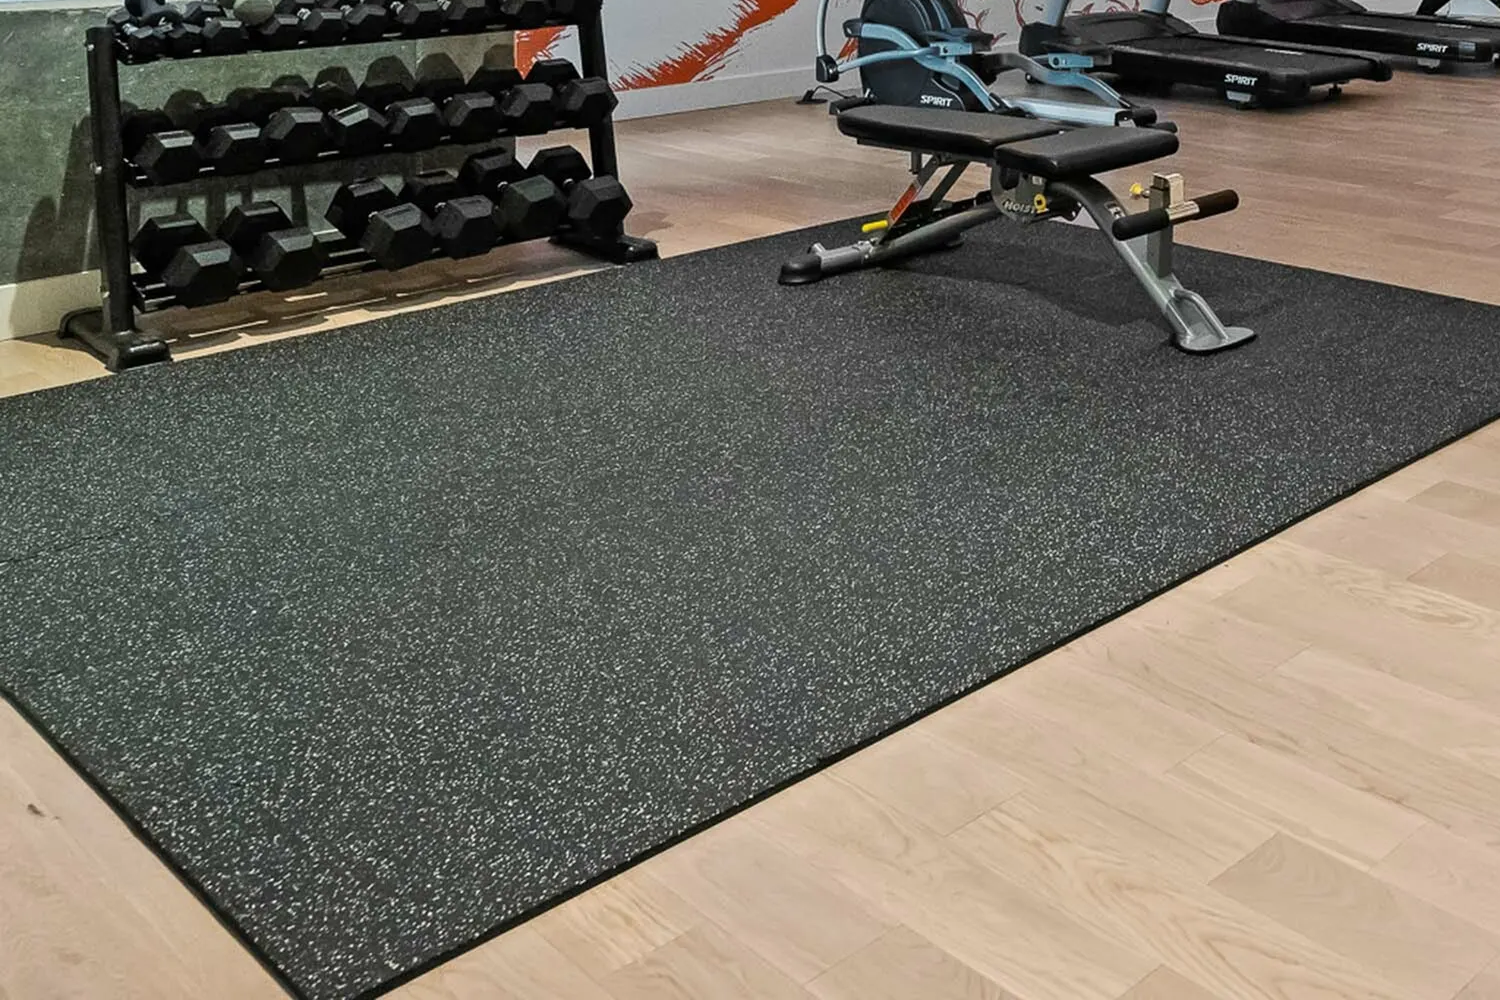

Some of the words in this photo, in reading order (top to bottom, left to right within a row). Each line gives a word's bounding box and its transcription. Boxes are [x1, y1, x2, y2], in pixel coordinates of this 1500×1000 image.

[1416, 42, 1449, 53] SPIRIT
[1224, 73, 1258, 86] SPIRIT
[920, 94, 953, 107] SPIRIT
